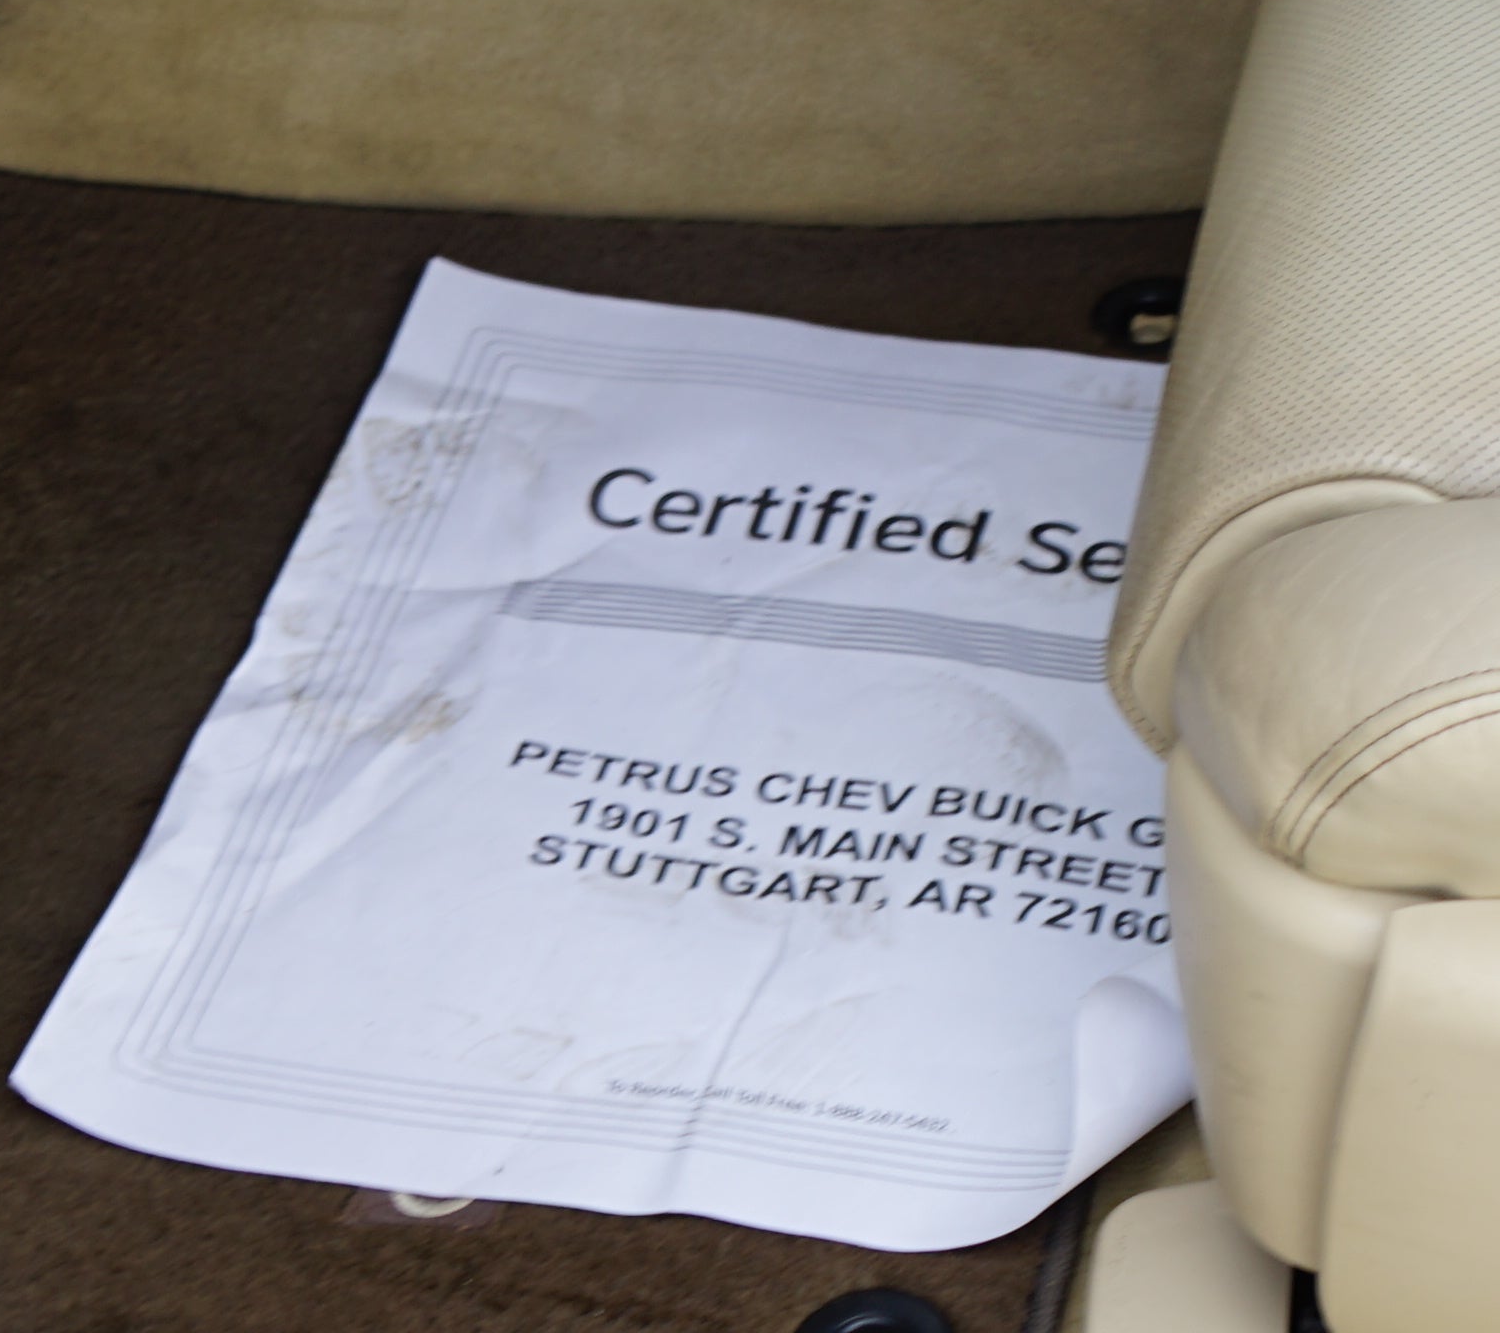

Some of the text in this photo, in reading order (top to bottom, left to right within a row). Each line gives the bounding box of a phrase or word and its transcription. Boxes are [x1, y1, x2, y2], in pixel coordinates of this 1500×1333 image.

[588, 467, 1127, 584] Certified Se
[508, 739, 1166, 848] PETRUS CHEV BUICK G
[569, 797, 1166, 898] 1901 S. MAIN STREET
[528, 834, 1171, 945] STUTTGART, AR 72160
